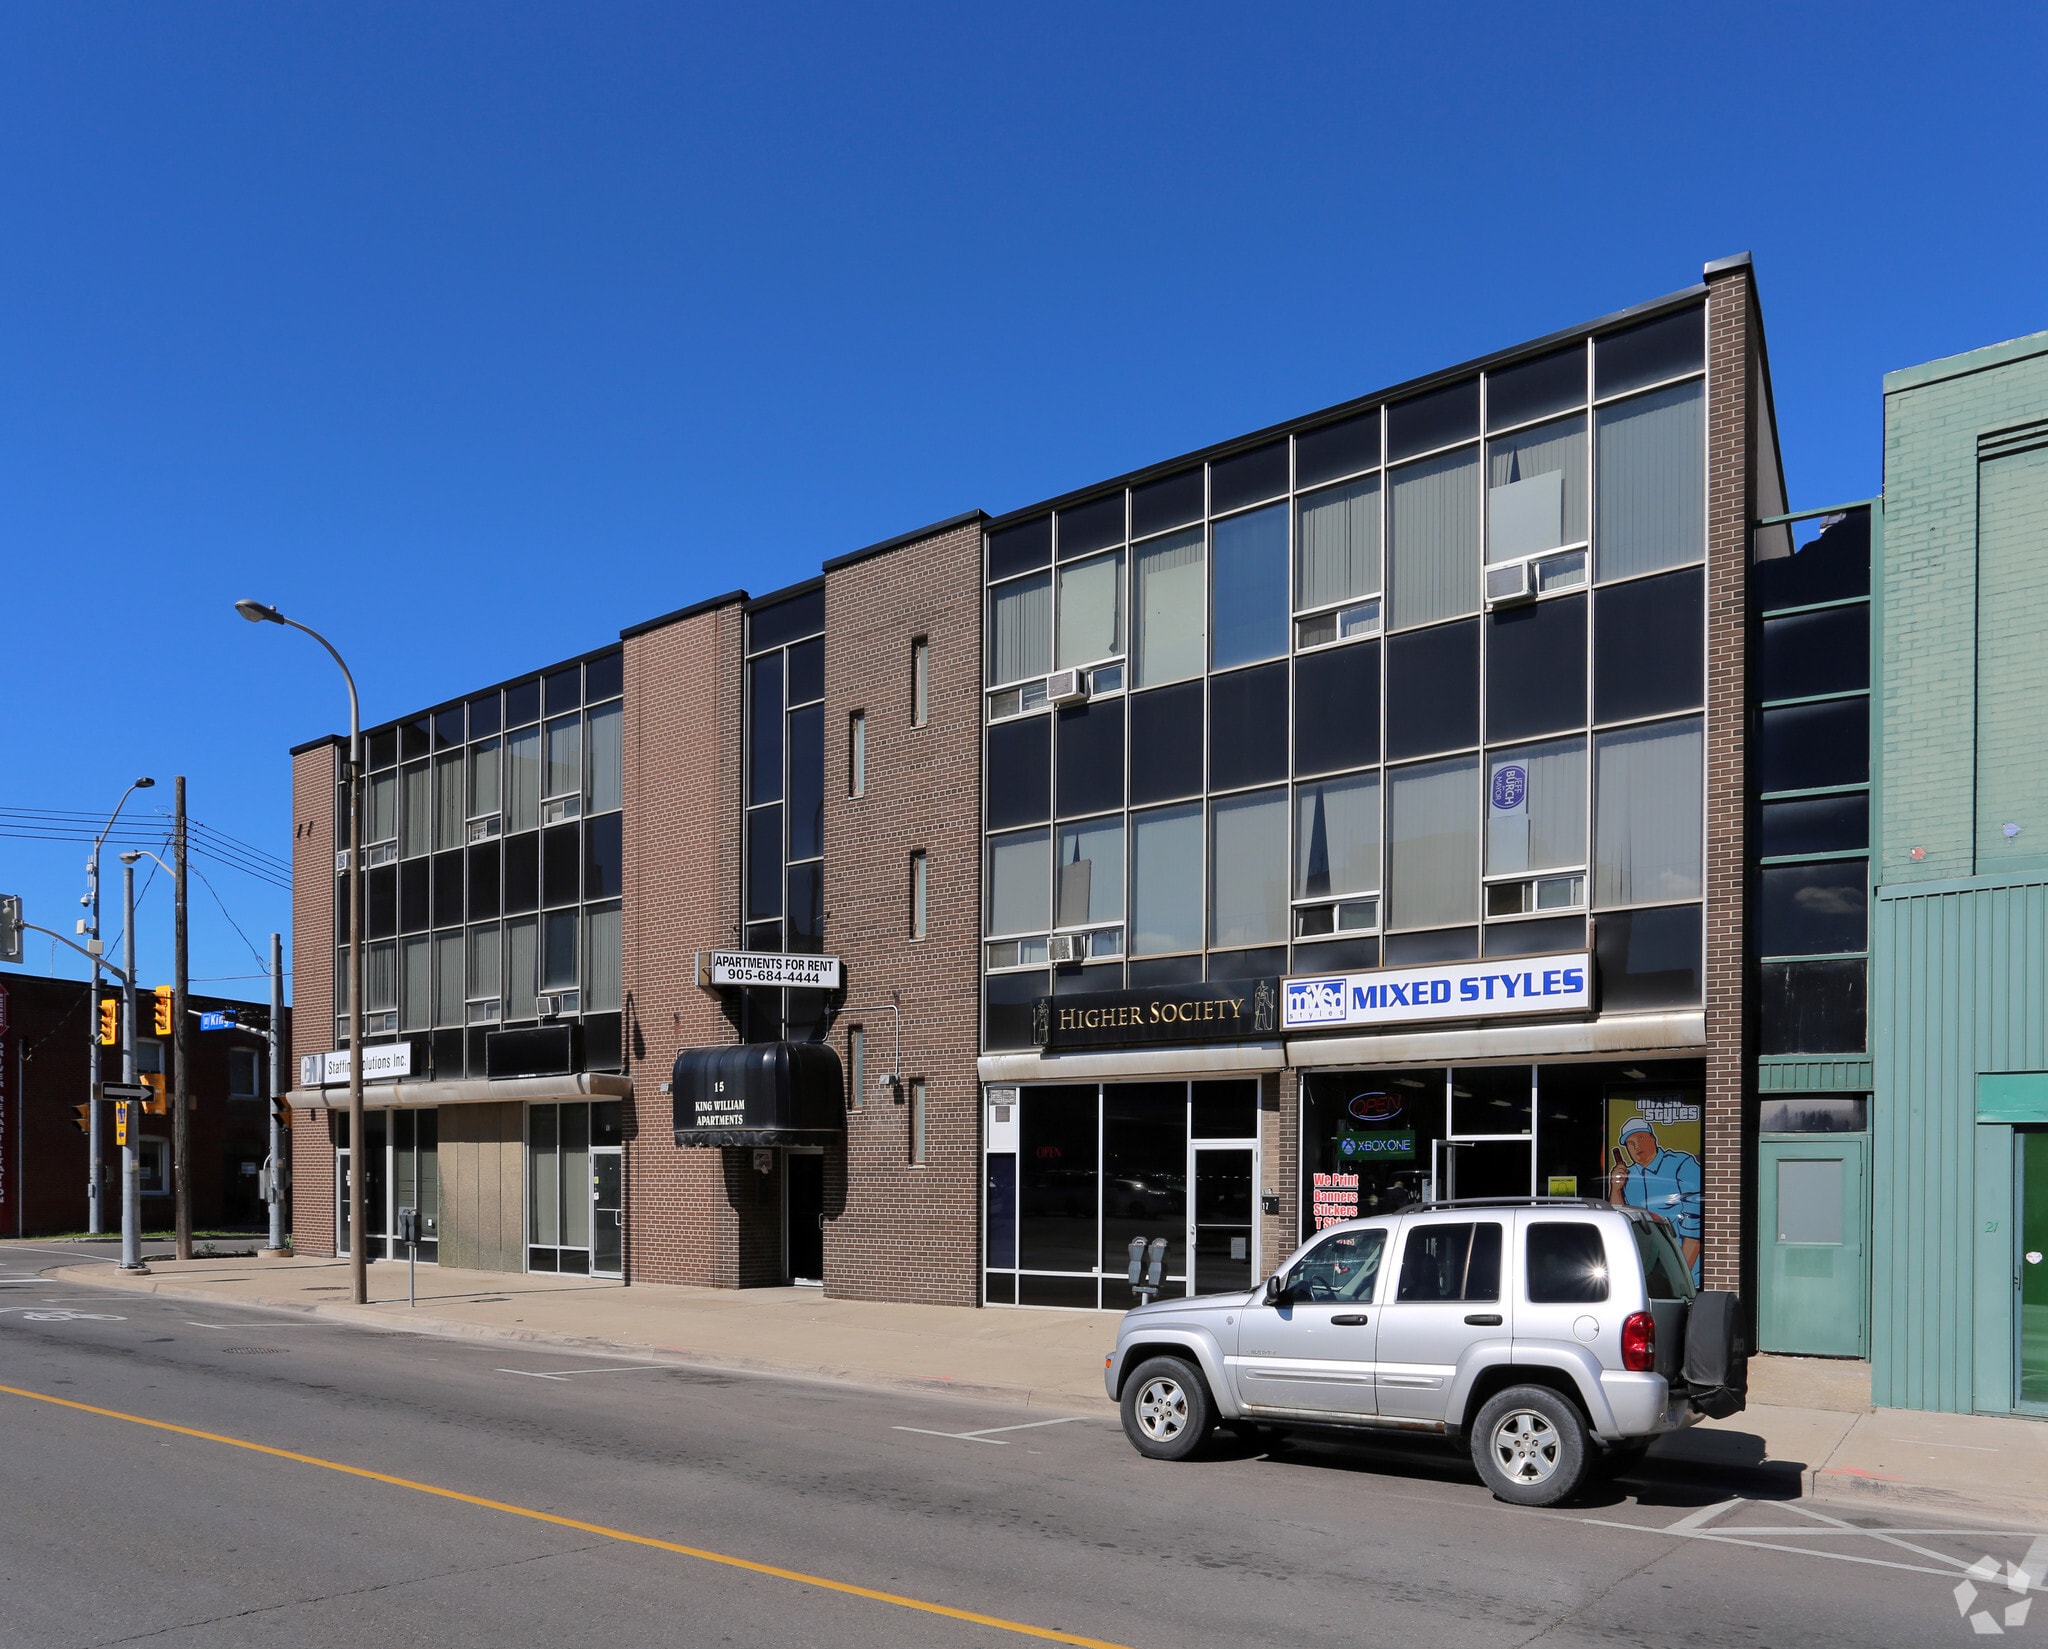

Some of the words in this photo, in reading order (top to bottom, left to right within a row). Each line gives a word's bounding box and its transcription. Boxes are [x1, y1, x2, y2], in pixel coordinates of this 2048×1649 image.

[1495, 776, 1503, 801] MAYOR
[1504, 770, 1516, 805] BURCH
[1514, 777, 1523, 794] JEFF
[715, 955, 782, 970] APARTMENTS
[785, 959, 805, 971] FOR
[808, 960, 834, 972] RENT
[727, 968, 820, 984] 905-684-4444
[1352, 979, 1451, 1010] MIXED
[1460, 967, 1584, 1002] STYLES
[1058, 1006, 1145, 1031] HIGHER
[1148, 998, 1245, 1025] SOCIETY
[1289, 1010, 1344, 1020] styles
[328, 1059, 351, 1075] Staffin
[362, 1055, 391, 1071] olutions
[393, 1053, 407, 1067] Inc.
[714, 1081, 725, 1093] 15
[695, 1101, 713, 1112] KING
[713, 1099, 745, 1111] WILLIAM
[1352, 1095, 1403, 1115] OPEN
[696, 1114, 744, 1126] APARTMENTS
[1645, 1108, 1698, 1124] styles
[1357, 1139, 1387, 1152] XBOX
[1387, 1139, 1411, 1152] ONE
[1313, 1173, 1331, 1187] We
[1332, 1173, 1359, 1187] Print
[1313, 1190, 1358, 1203] Banners
[1262, 1202, 1269, 1210] 17
[1313, 1203, 1358, 1217] Stickers
[1314, 1217, 1322, 1230] T
[1984, 1220, 1999, 1233] 21
